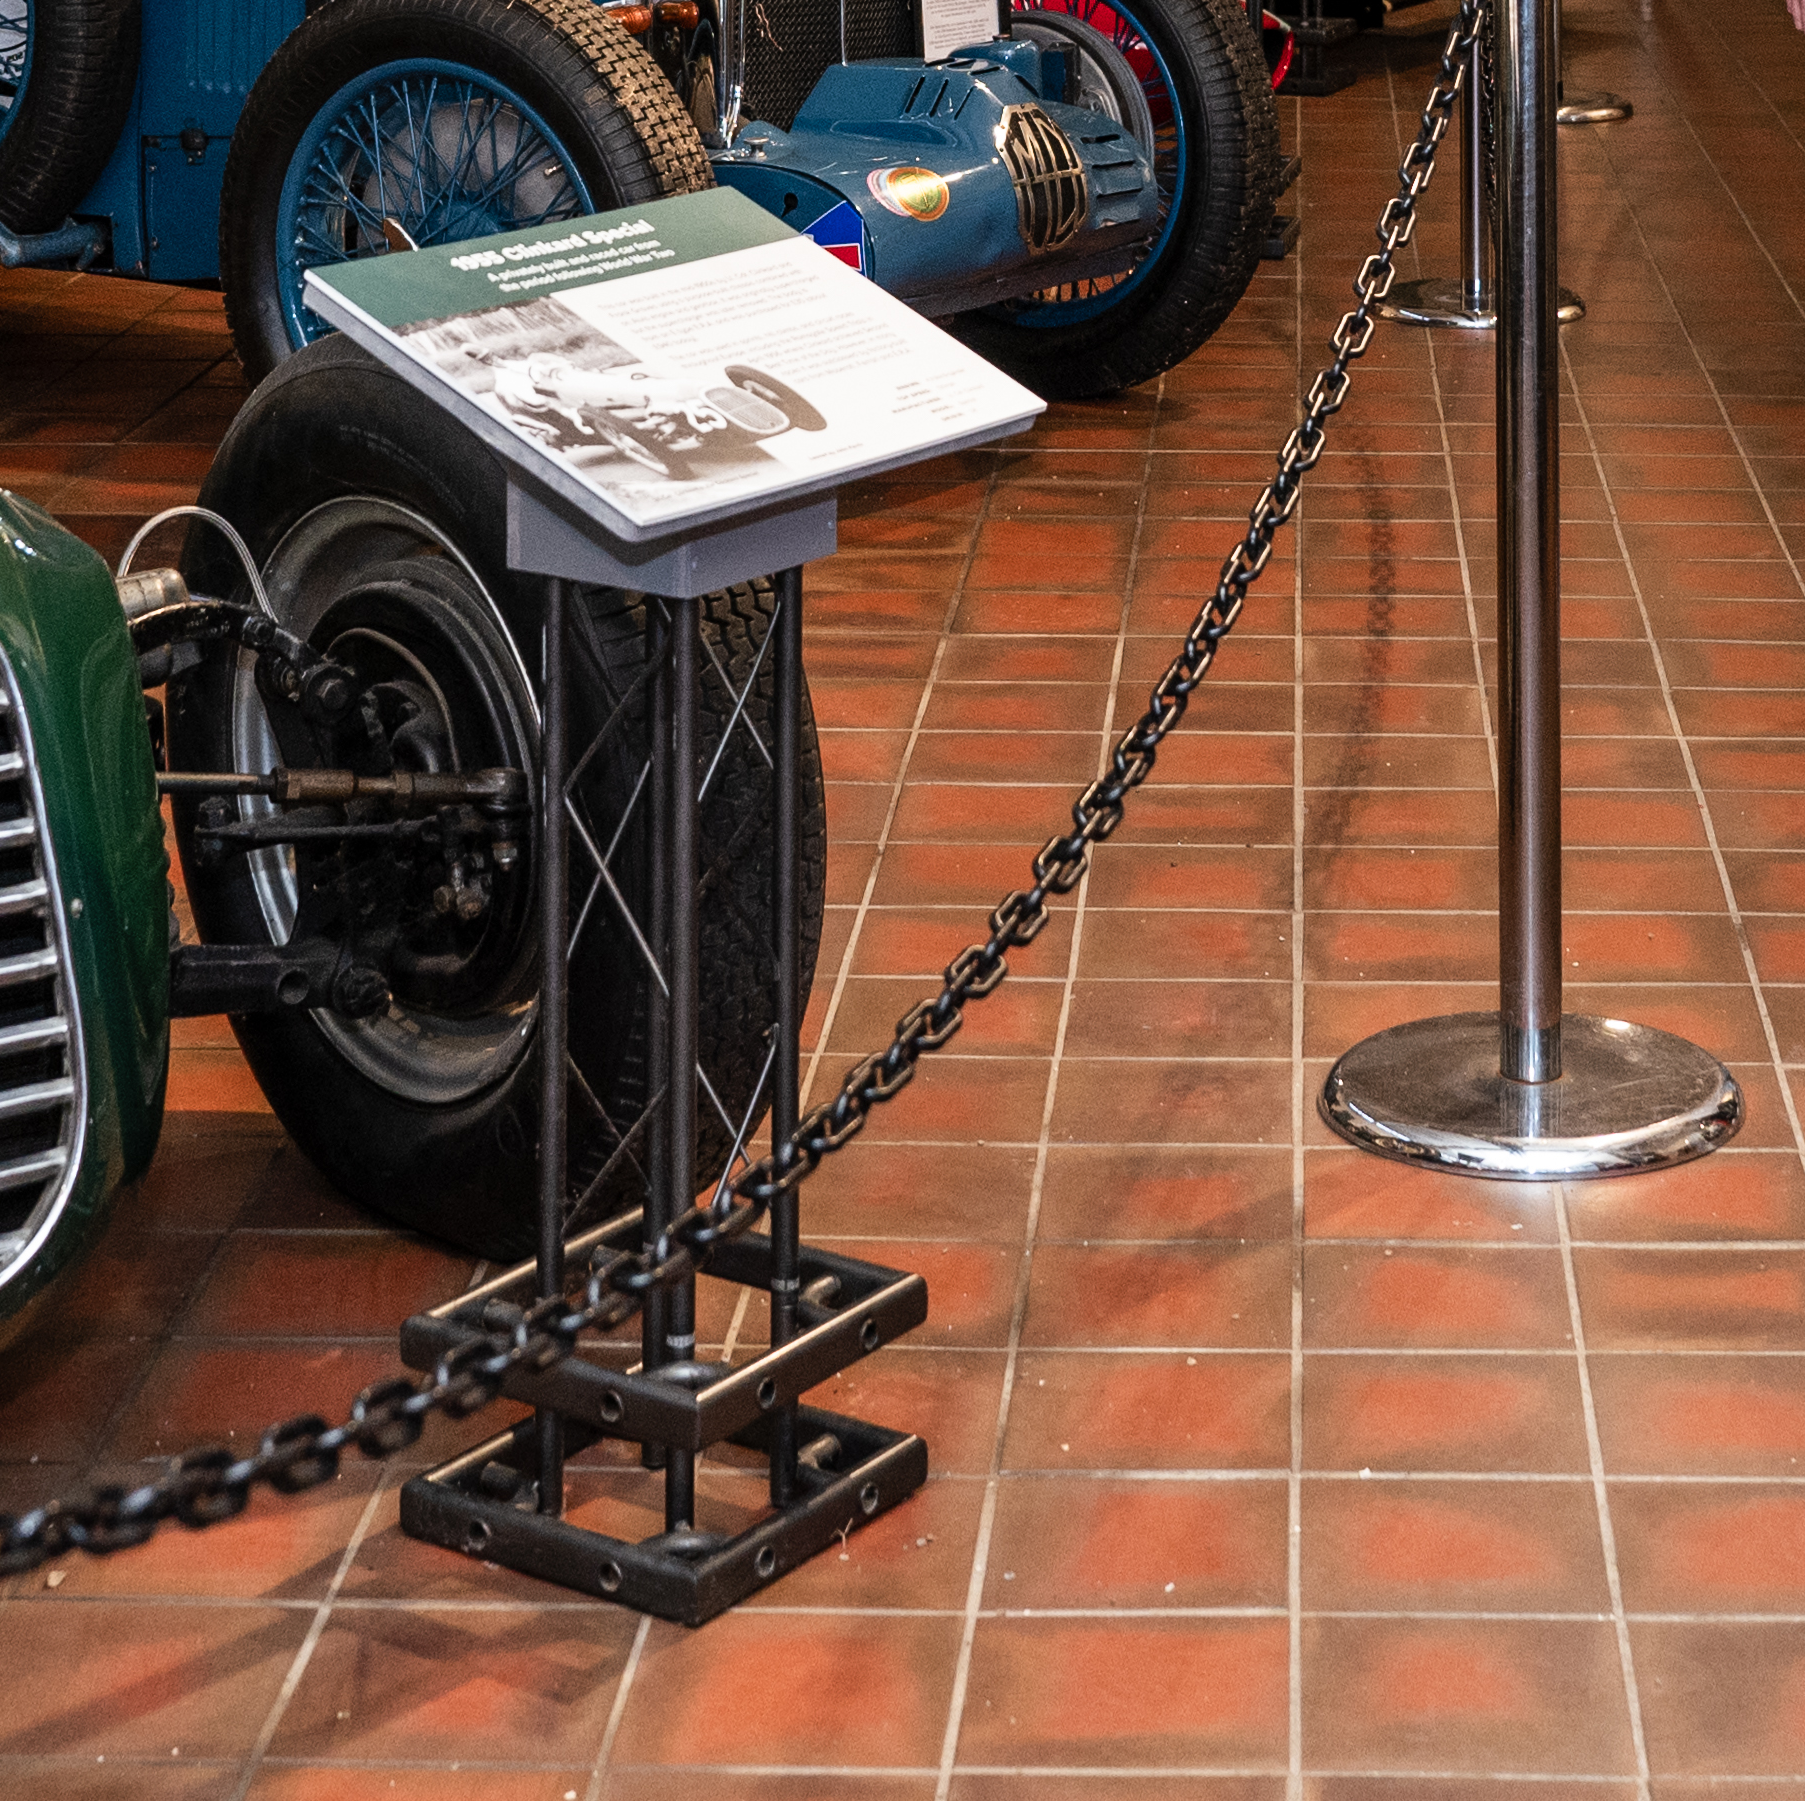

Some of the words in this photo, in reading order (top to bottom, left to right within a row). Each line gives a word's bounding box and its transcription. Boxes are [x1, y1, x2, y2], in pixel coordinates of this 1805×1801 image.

[449, 249, 506, 272] 1955
[501, 233, 588, 262] Clinkard
[581, 218, 656, 245] Special
[601, 255, 634, 273] World
[630, 252, 654, 265] War
[650, 248, 676, 261] Two
